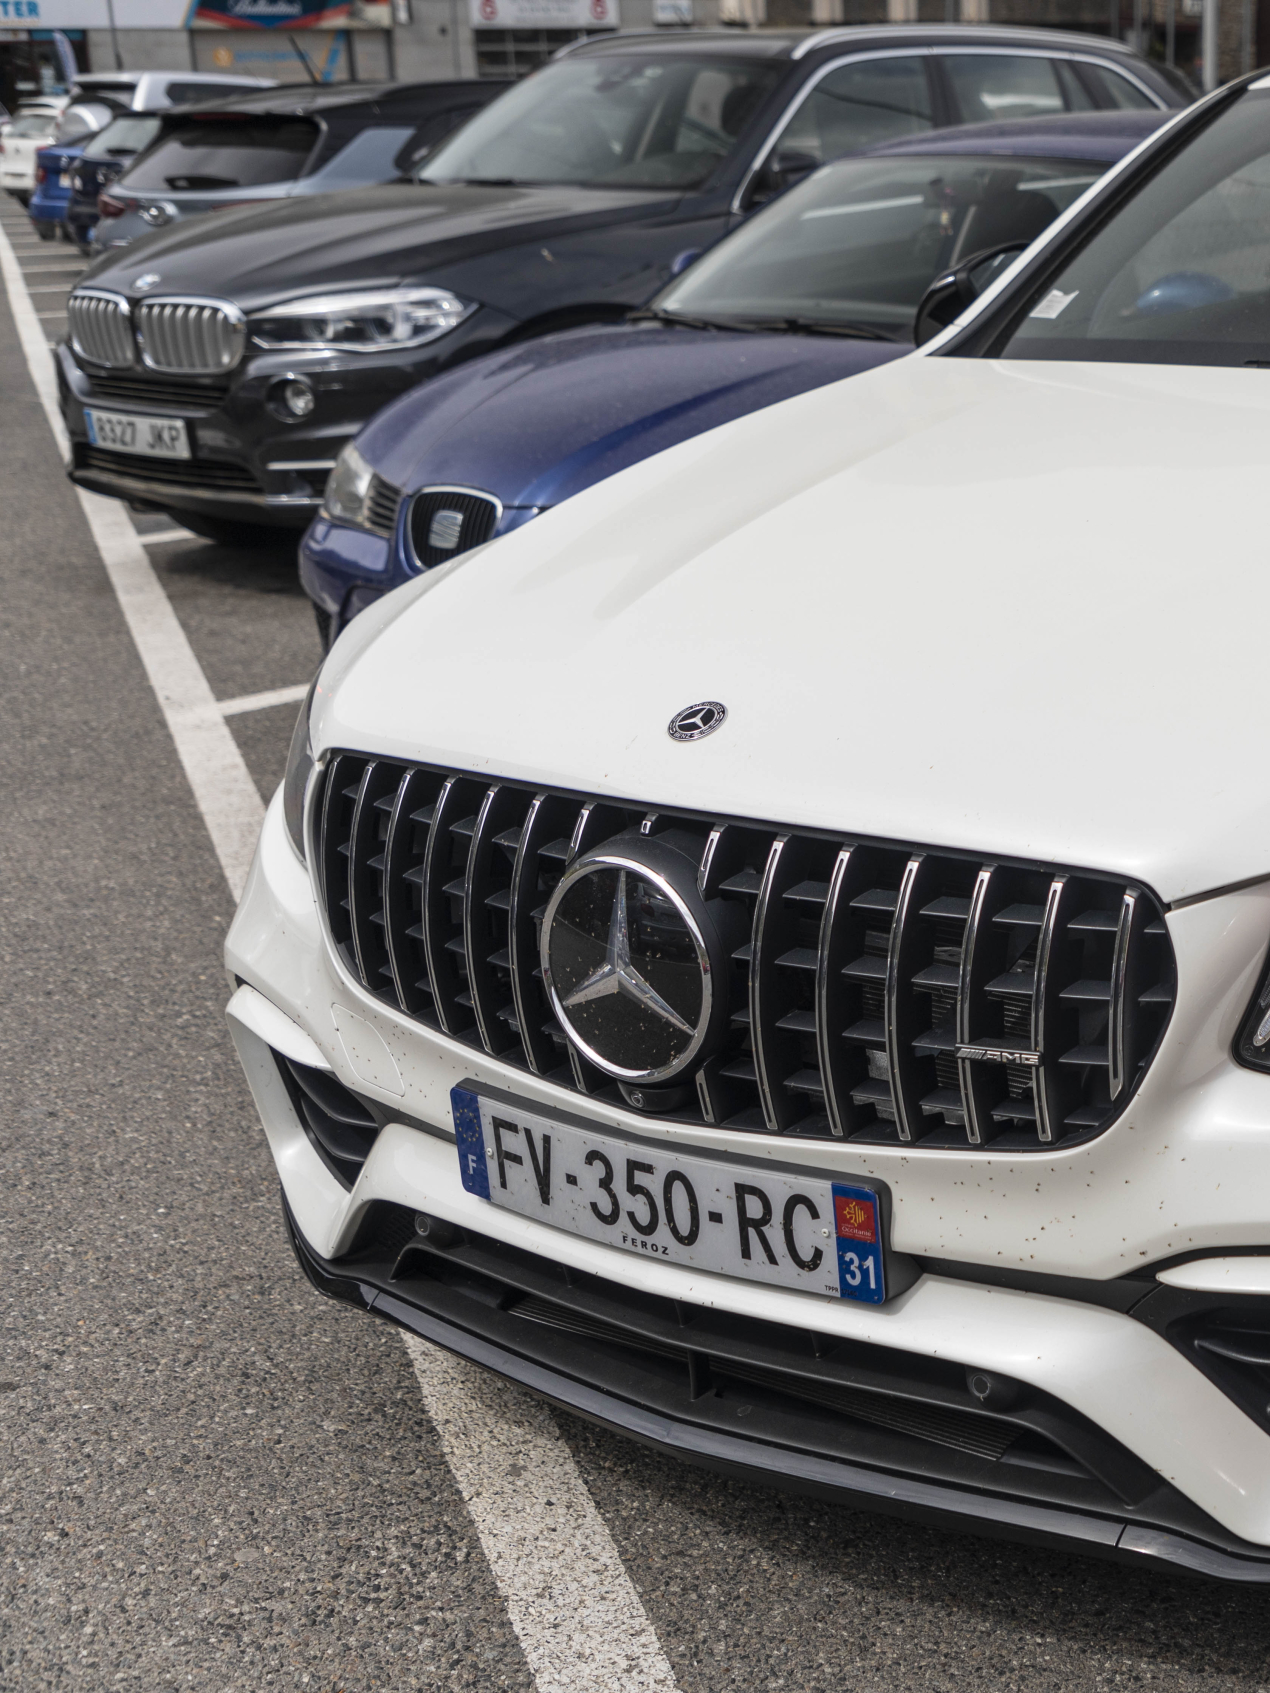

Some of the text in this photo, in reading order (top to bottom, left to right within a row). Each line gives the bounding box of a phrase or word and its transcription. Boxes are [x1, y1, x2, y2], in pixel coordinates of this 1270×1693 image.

[982, 1050, 1039, 1065] AMG
[467, 1154, 477, 1175] F
[491, 1115, 824, 1273] FV-350-RC
[622, 1234, 670, 1257] FEROZ
[844, 1251, 876, 1290] 31
